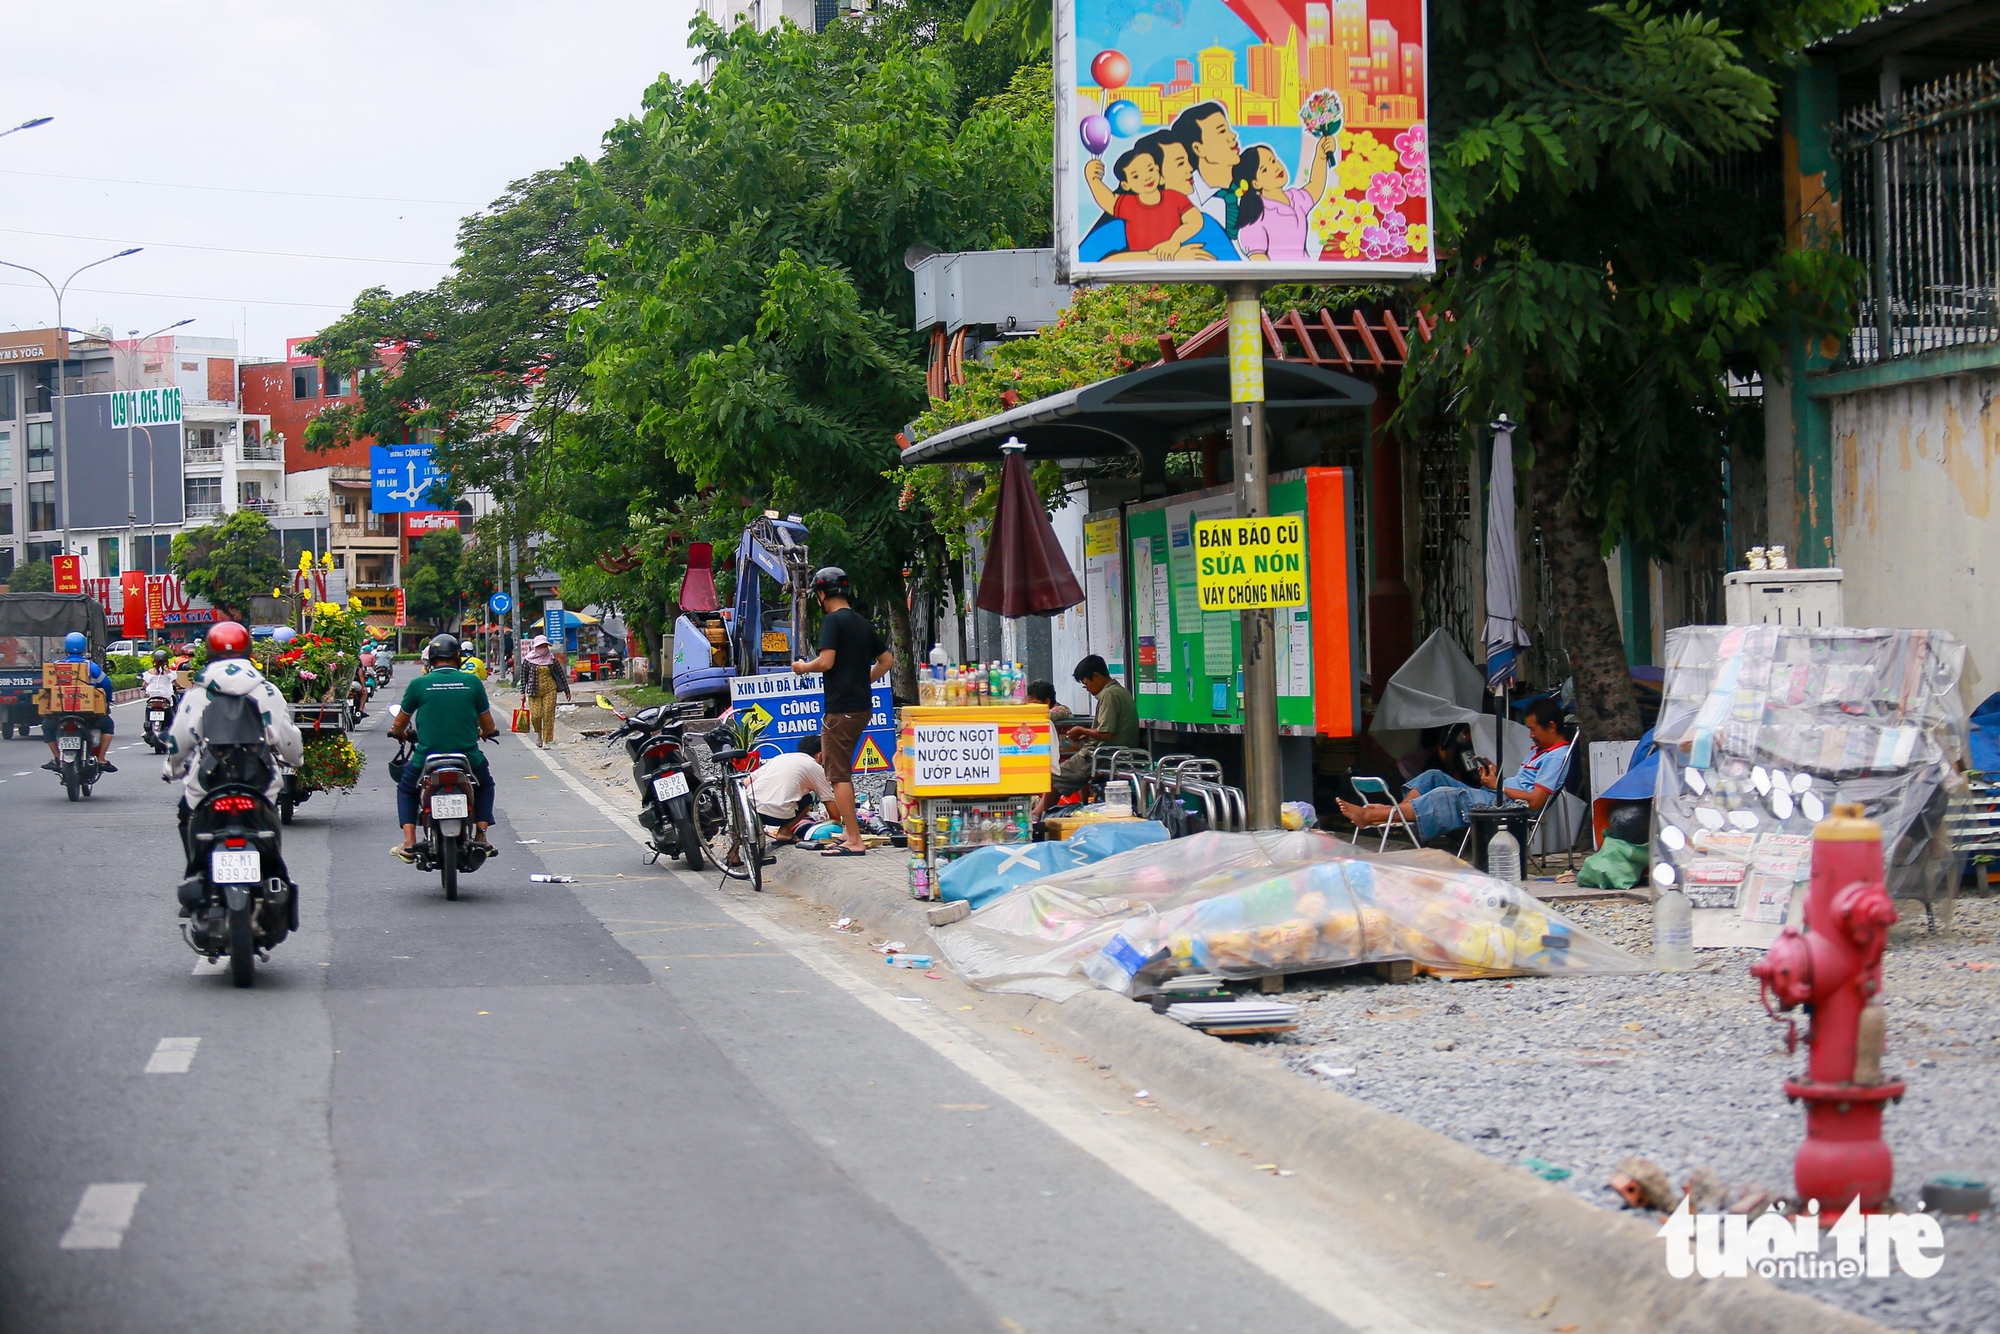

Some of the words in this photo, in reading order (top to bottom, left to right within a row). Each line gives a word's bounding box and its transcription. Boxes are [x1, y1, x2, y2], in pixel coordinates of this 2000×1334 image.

[20, 347, 45, 358] YOGA
[405, 447, 420, 457] CỘNG
[1200, 524, 1232, 548] BÁN
[1238, 522, 1271, 546] BÁO
[1277, 521, 1299, 544] CŨ
[1202, 551, 1246, 575] SỬA
[1254, 549, 1299, 573] NÓN
[1203, 582, 1224, 605] VÁY
[1228, 578, 1267, 604] CHỐNG
[1271, 576, 1301, 602] NẮNG
[186, 609, 213, 621] GIÁ
[737, 682, 755, 695] XIN
[758, 676, 774, 693] LỖI
[777, 677, 791, 692] ĐÃ
[780, 700, 820, 716] CÔNG
[777, 719, 818, 733] ĐANG
[918, 727, 956, 743] NƯỚC
[959, 730, 994, 745] NGỌT
[918, 746, 958, 761] NƯỚC
[923, 764, 952, 779] ƯỚP
[956, 766, 990, 782] LẠNH
[659, 775, 681, 790] 59-P2
[660, 784, 687, 800] 867.51
[437, 807, 463, 817] 5330
[221, 855, 252, 867] 62-M1
[217, 868, 258, 880] 839.20
